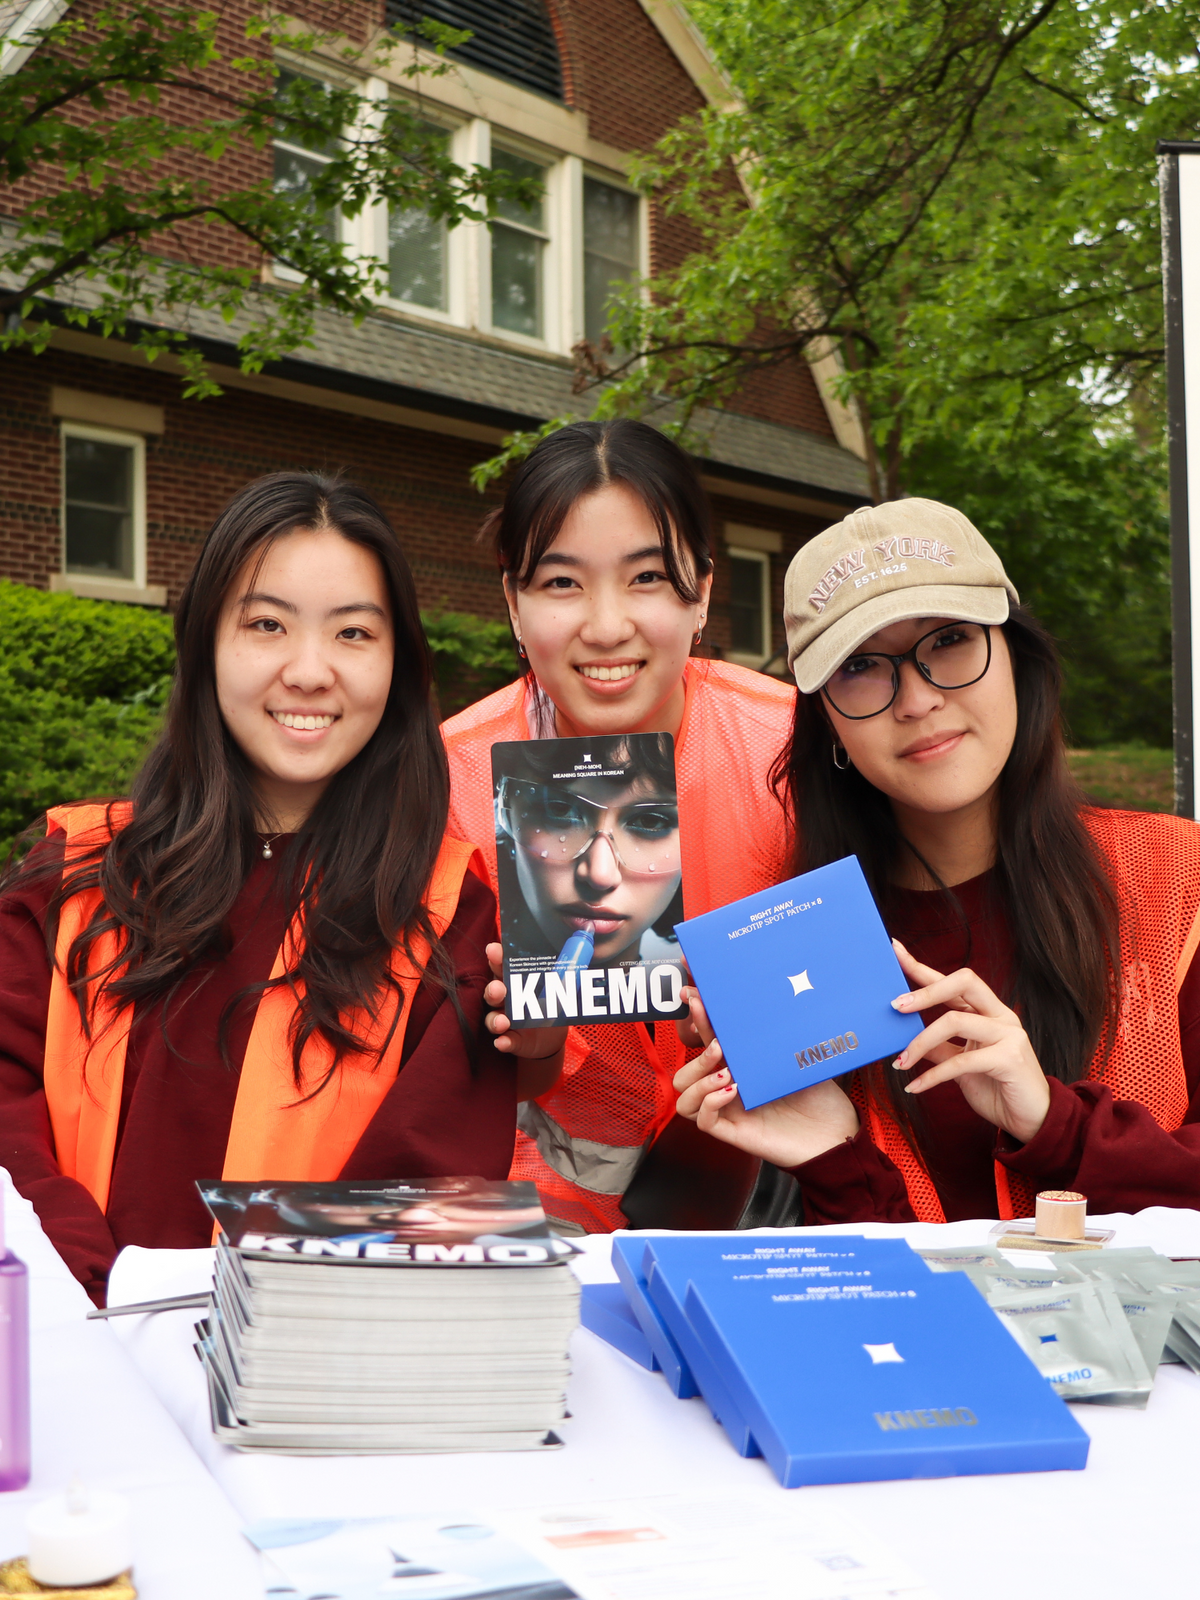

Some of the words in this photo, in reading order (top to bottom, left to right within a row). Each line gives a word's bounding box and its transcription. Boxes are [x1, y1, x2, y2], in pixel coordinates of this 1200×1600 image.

[808, 548, 866, 614] NEW
[873, 535, 956, 568] YORK
[854, 571, 878, 588] EST.
[728, 920, 763, 940] MICROTIP
[764, 912, 785, 926] SPOT
[786, 902, 811, 917] PATCH
[816, 897, 823, 905] 8
[750, 908, 772, 922] RIGHT
[773, 900, 793, 914] AWAY
[509, 964, 683, 1021] KNEMO
[794, 1031, 859, 1070] KNEMO
[238, 1234, 548, 1262] KNEMO
[1045, 1368, 1092, 1383] NEMO
[874, 1407, 978, 1431] KNEMO
